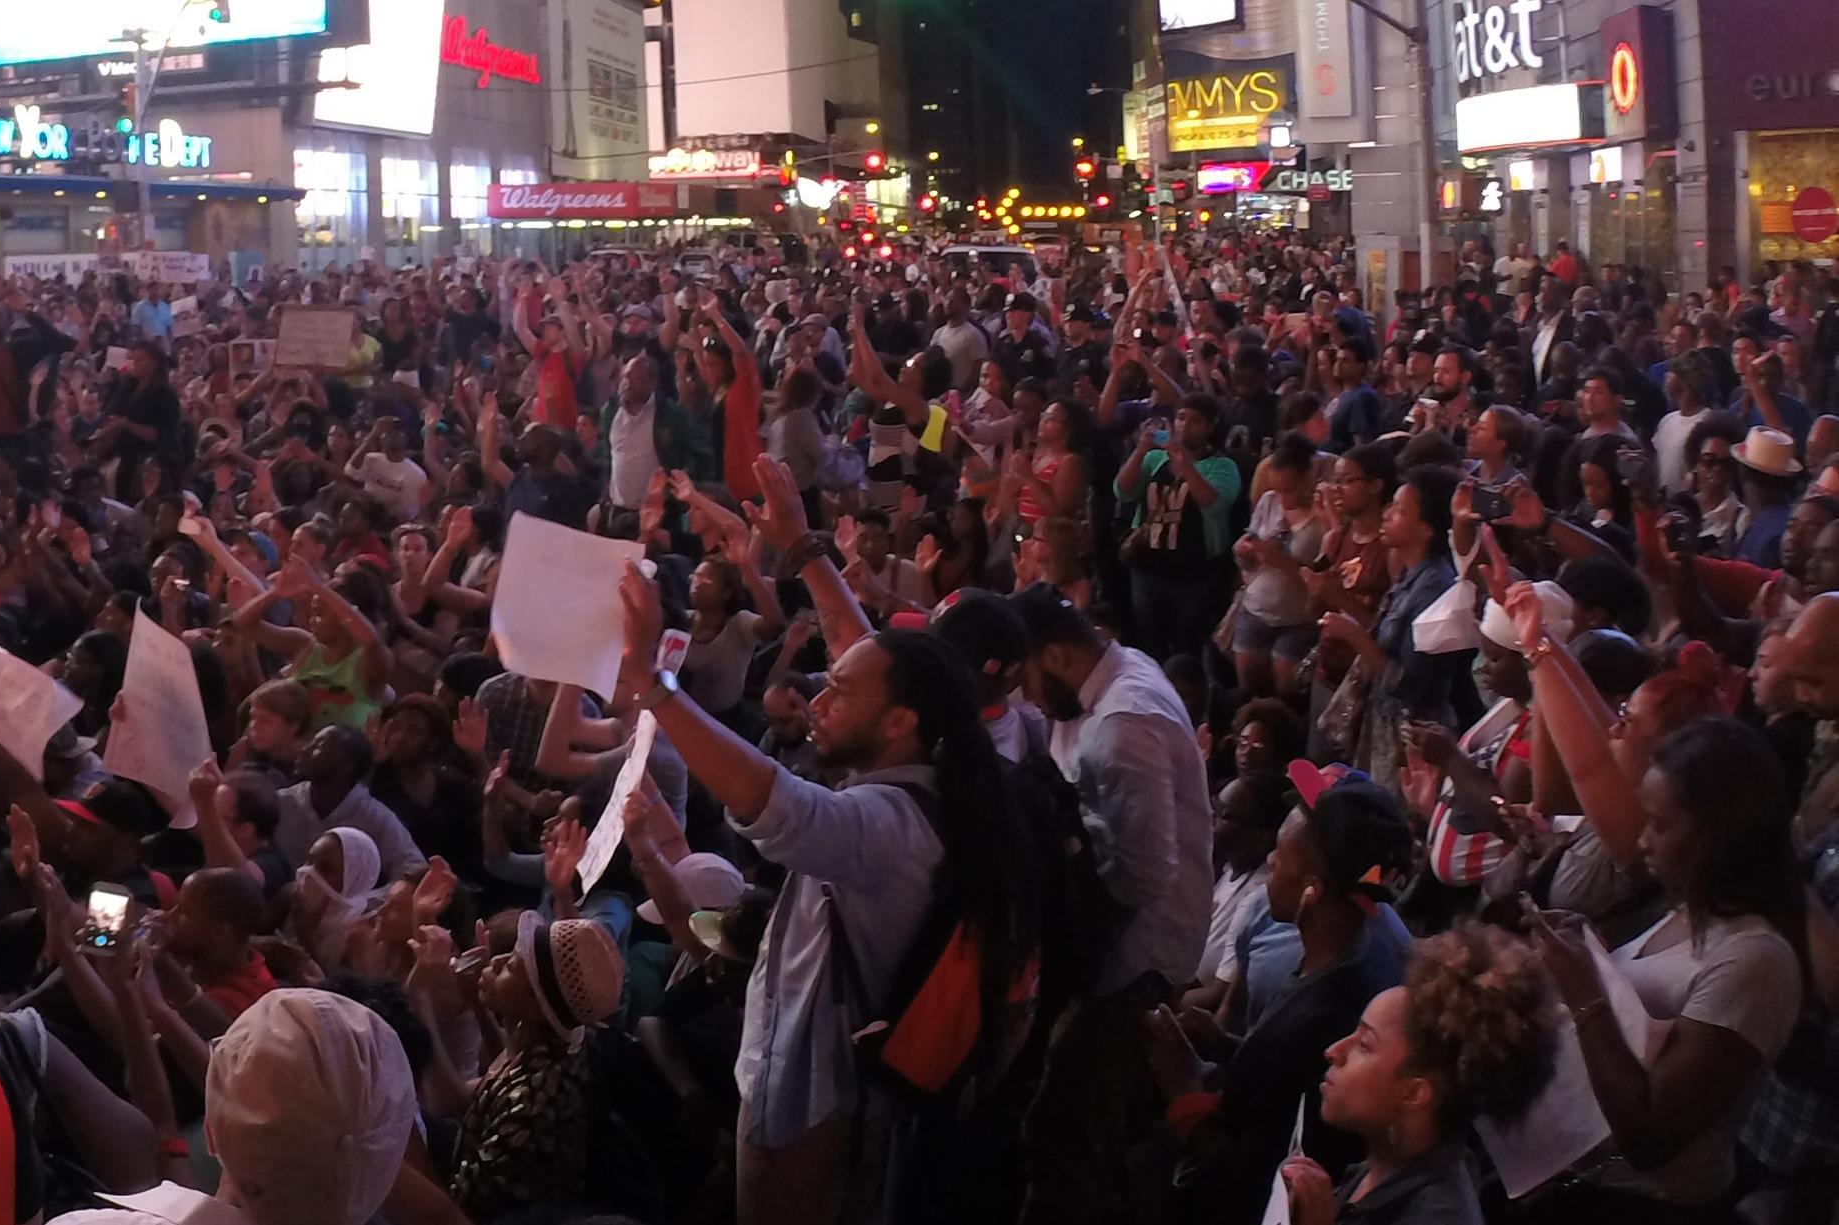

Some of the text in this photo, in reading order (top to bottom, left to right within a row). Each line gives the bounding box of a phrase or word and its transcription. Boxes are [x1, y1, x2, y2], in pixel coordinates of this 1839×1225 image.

[1455, 0, 1543, 83] at&t
[1276, 169, 1353, 190] CHASE
[501, 187, 627, 215] Walgreens
